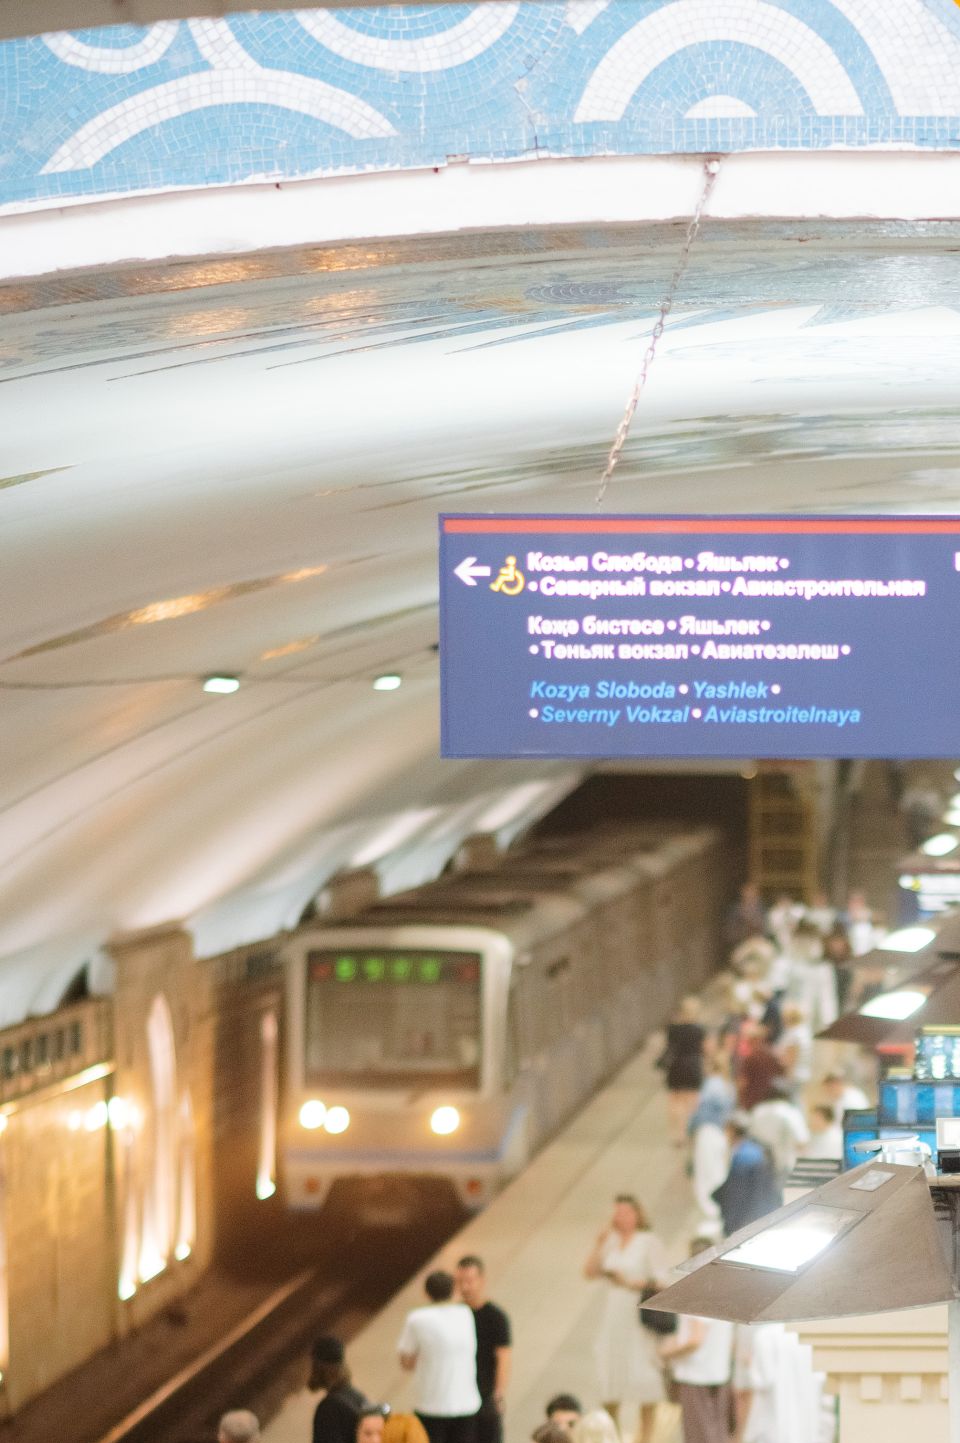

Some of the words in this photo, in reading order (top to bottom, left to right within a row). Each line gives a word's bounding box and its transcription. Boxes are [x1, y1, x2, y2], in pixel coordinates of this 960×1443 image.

[591, 551, 683, 575] Слобода
[539, 576, 646, 600] Северный
[731, 576, 926, 600] Авиастроительная
[618, 644, 689, 659] вокзал
[530, 681, 591, 702] Kozya
[595, 681, 675, 699] Sloboda
[693, 681, 768, 699] Yashlek
[541, 705, 621, 727] Severny
[626, 705, 690, 723] Vokzal
[703, 705, 862, 727] Aviastroitelnaya
